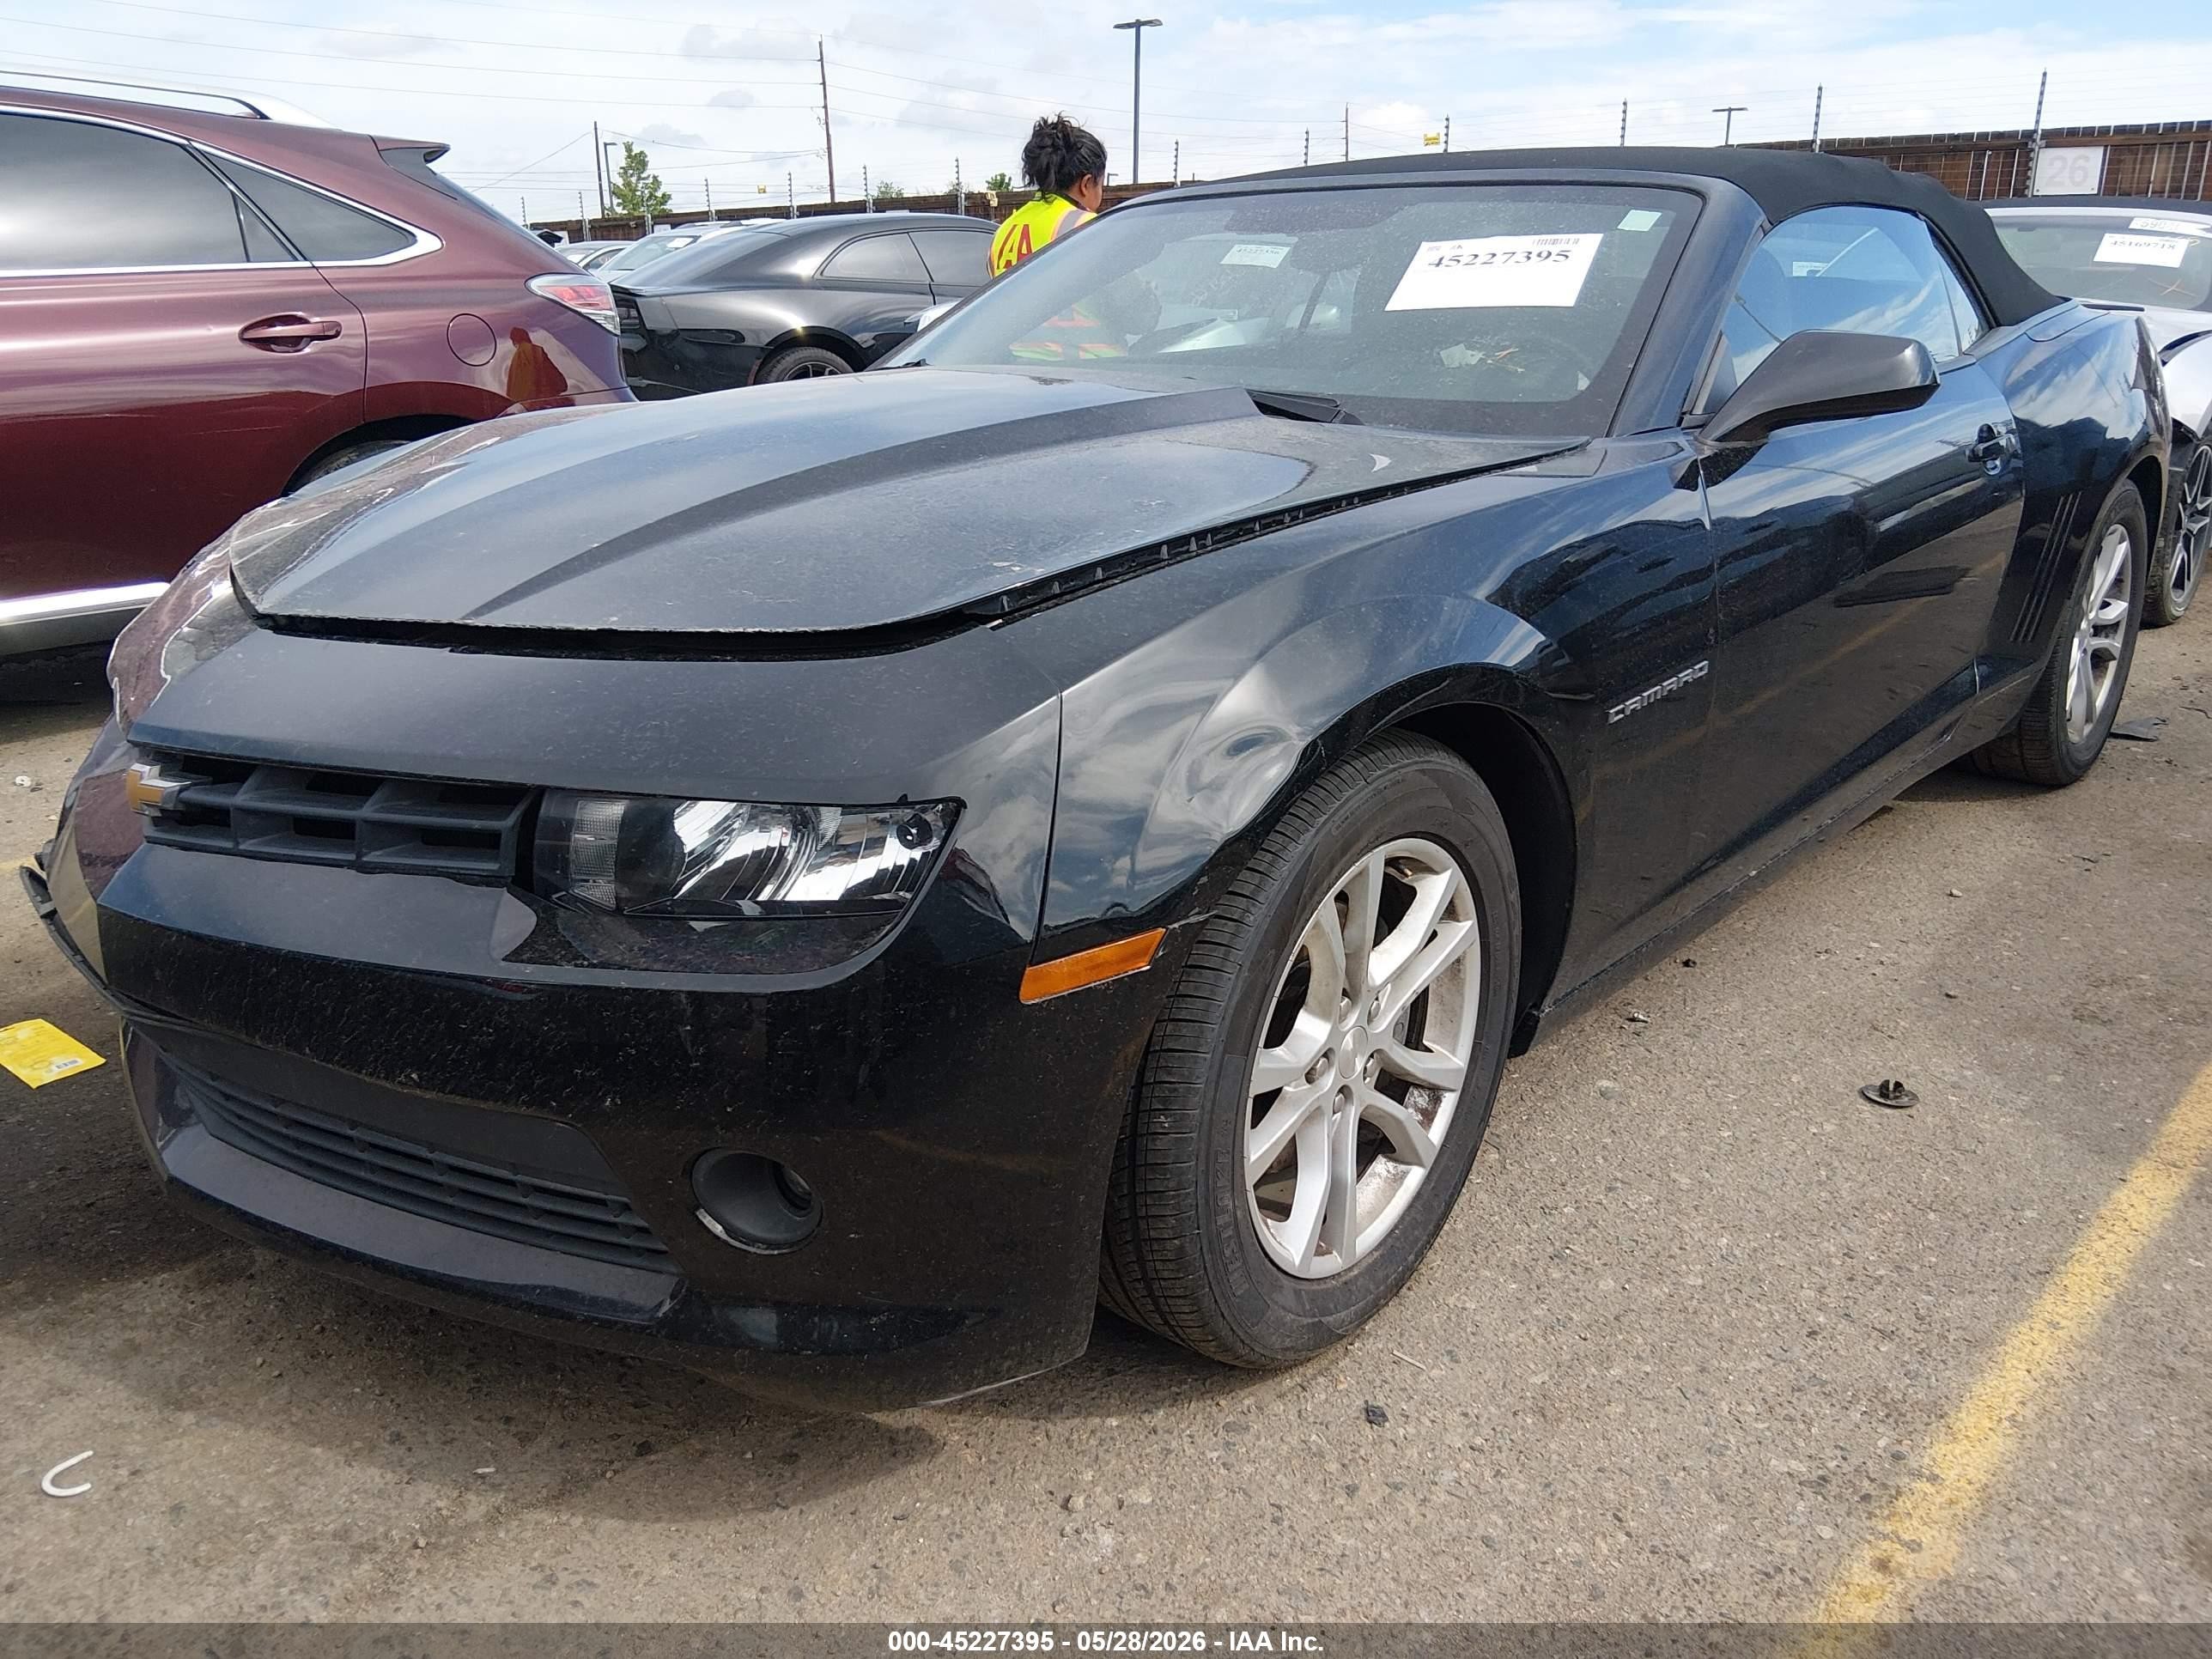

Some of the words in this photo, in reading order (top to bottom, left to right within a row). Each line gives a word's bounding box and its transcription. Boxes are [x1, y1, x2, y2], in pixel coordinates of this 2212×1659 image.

[2045, 154, 2090, 187] 26
[1428, 250, 1572, 268] 45227395
[1607, 660, 1709, 725] CAMARO
